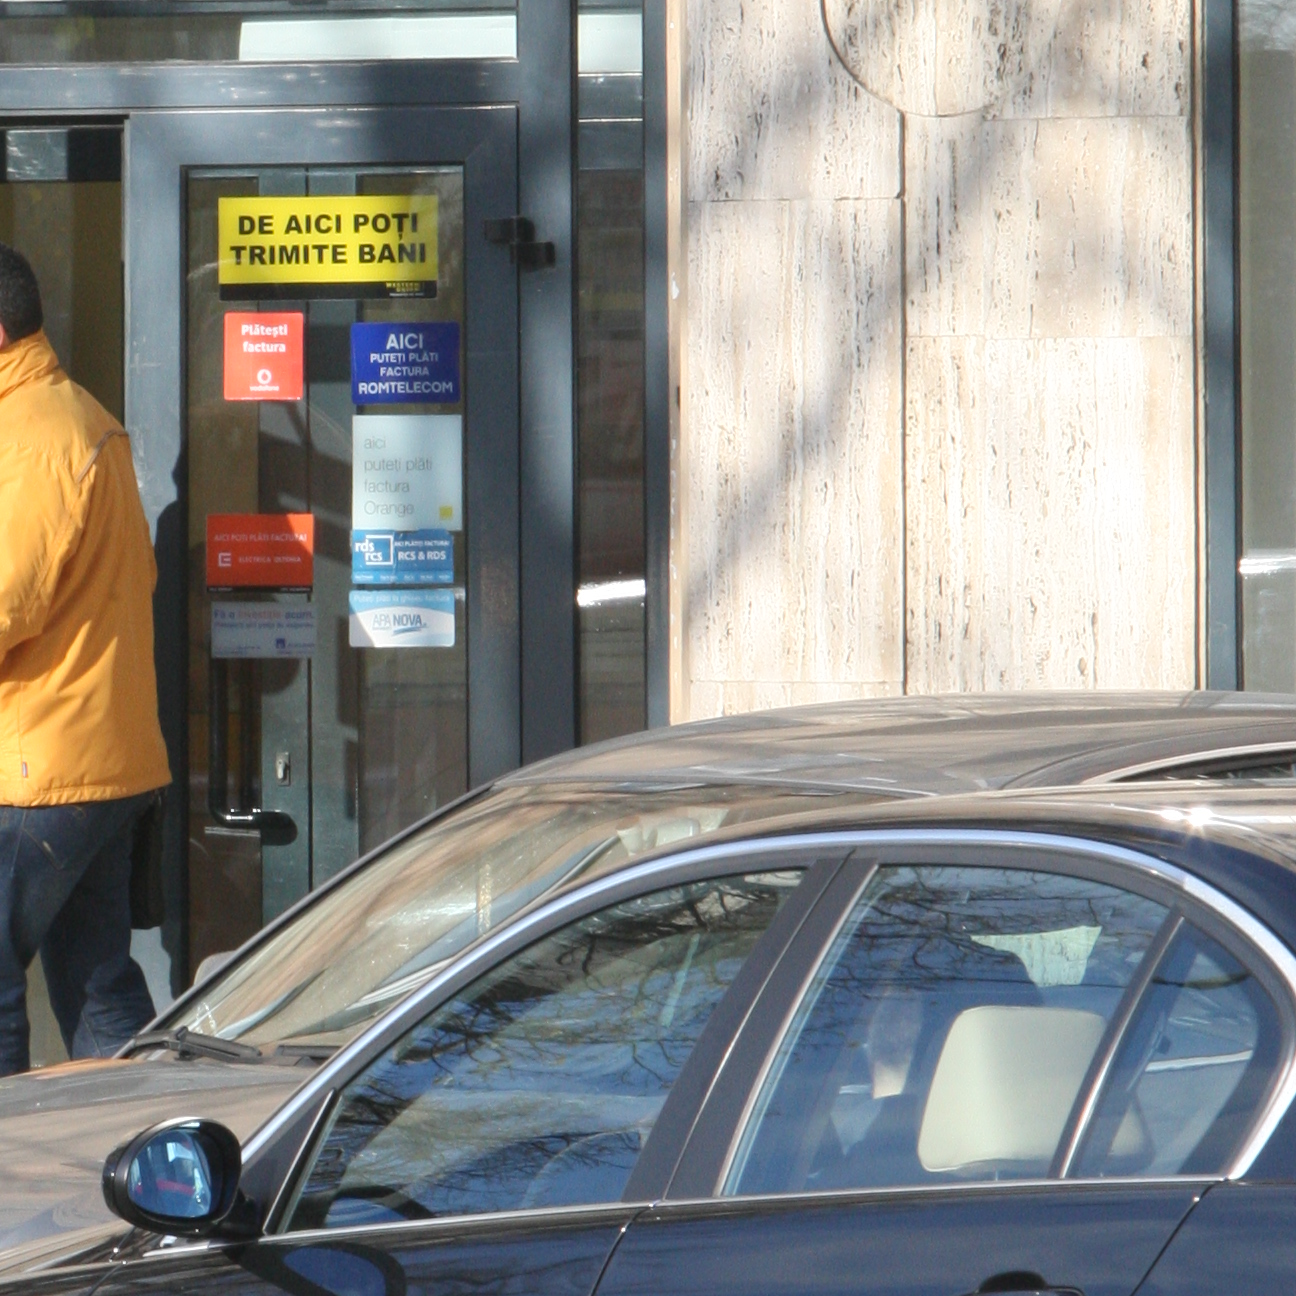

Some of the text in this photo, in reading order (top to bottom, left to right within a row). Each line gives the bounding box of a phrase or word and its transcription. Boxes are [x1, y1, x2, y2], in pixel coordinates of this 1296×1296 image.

[238, 215, 274, 235] DE
[284, 214, 342, 235] AICI
[230, 243, 426, 265] TRIMITE BANI
[243, 341, 286, 353] factura
[386, 333, 423, 350] AICI
[380, 366, 429, 377] FACTURA
[358, 382, 453, 395] ROMTELECOM
[364, 436, 386, 449] aici
[364, 480, 410, 493] factura
[364, 501, 415, 517] Orange
[354, 539, 375, 552] rds
[365, 552, 383, 561] rcs
[398, 550, 447, 560] RCS & RDS
[393, 613, 423, 626] NOVA
